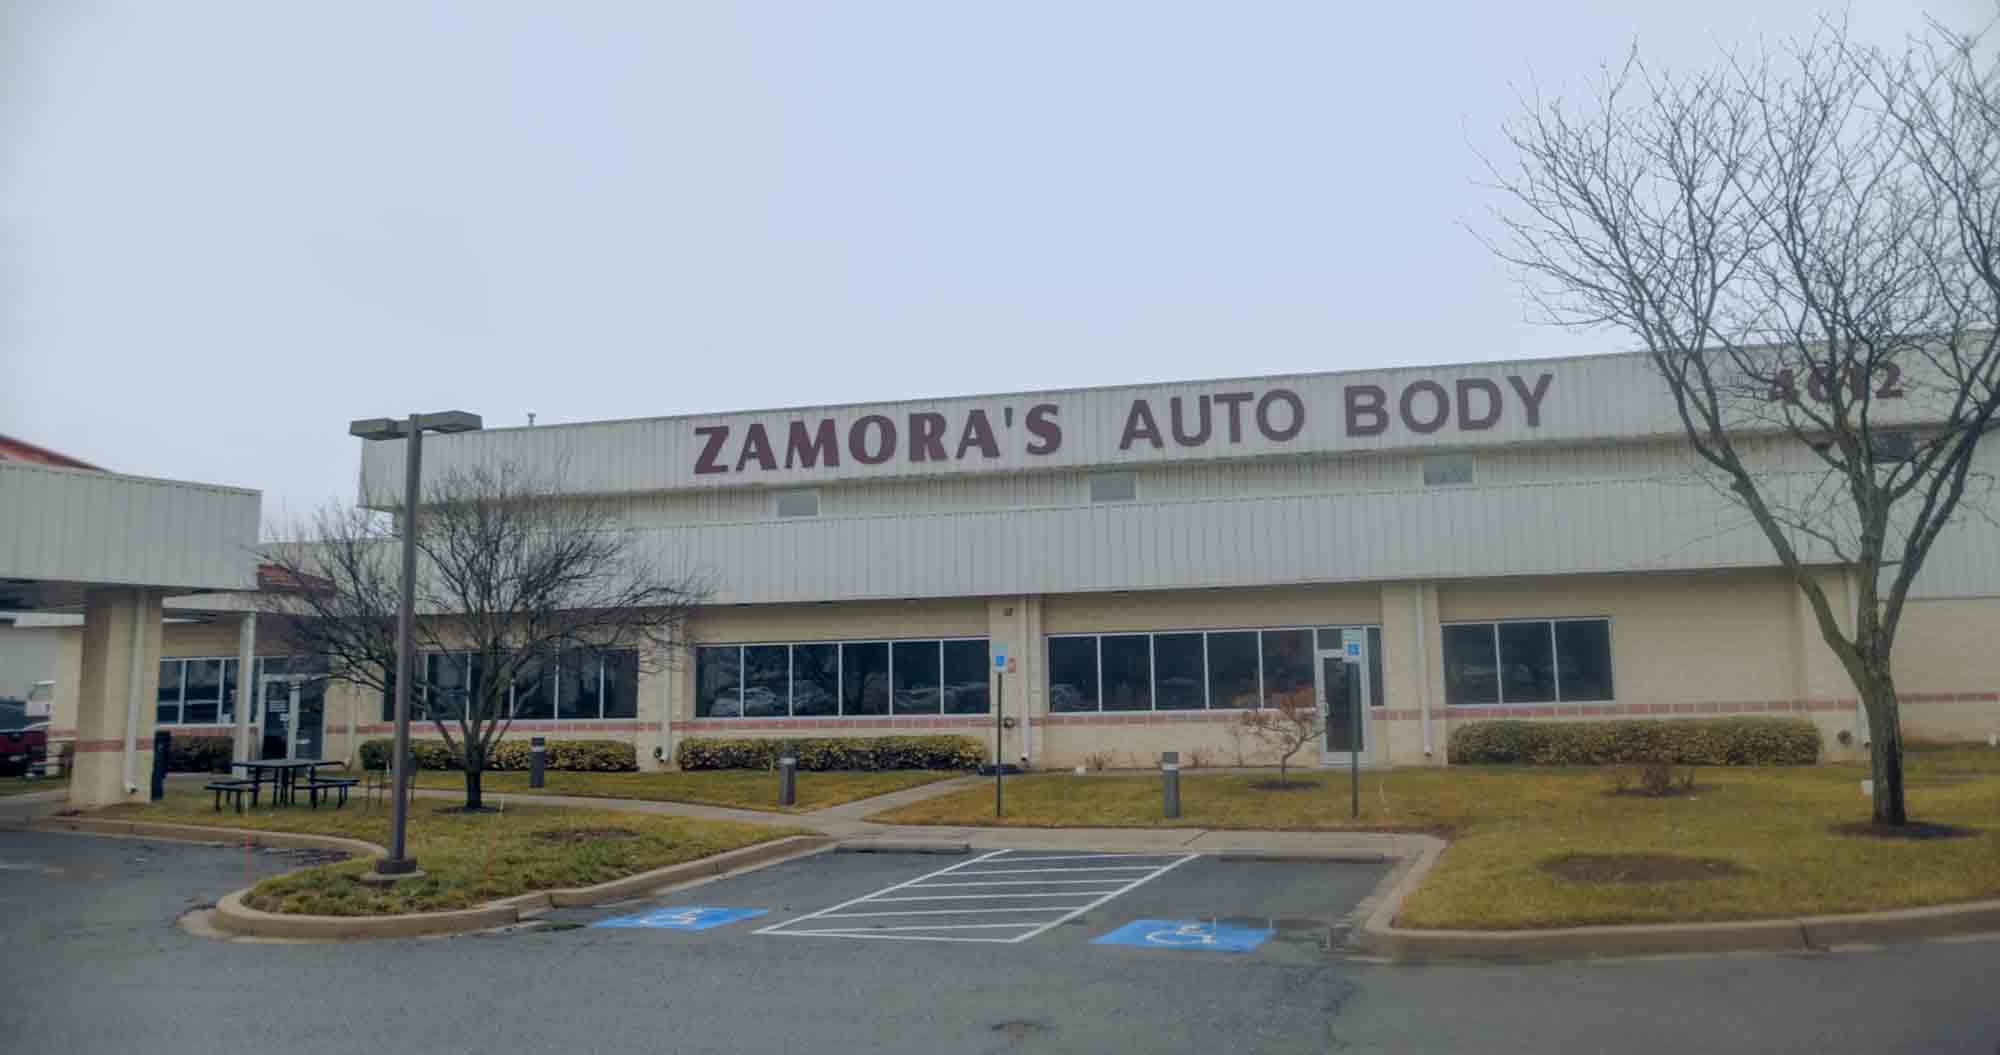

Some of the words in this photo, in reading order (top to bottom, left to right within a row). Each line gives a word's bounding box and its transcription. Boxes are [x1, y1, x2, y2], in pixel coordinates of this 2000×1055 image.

[694, 404, 1062, 474] ZAMORA'S
[1119, 388, 1305, 450] AUTO
[1344, 373, 1553, 438] BODY
